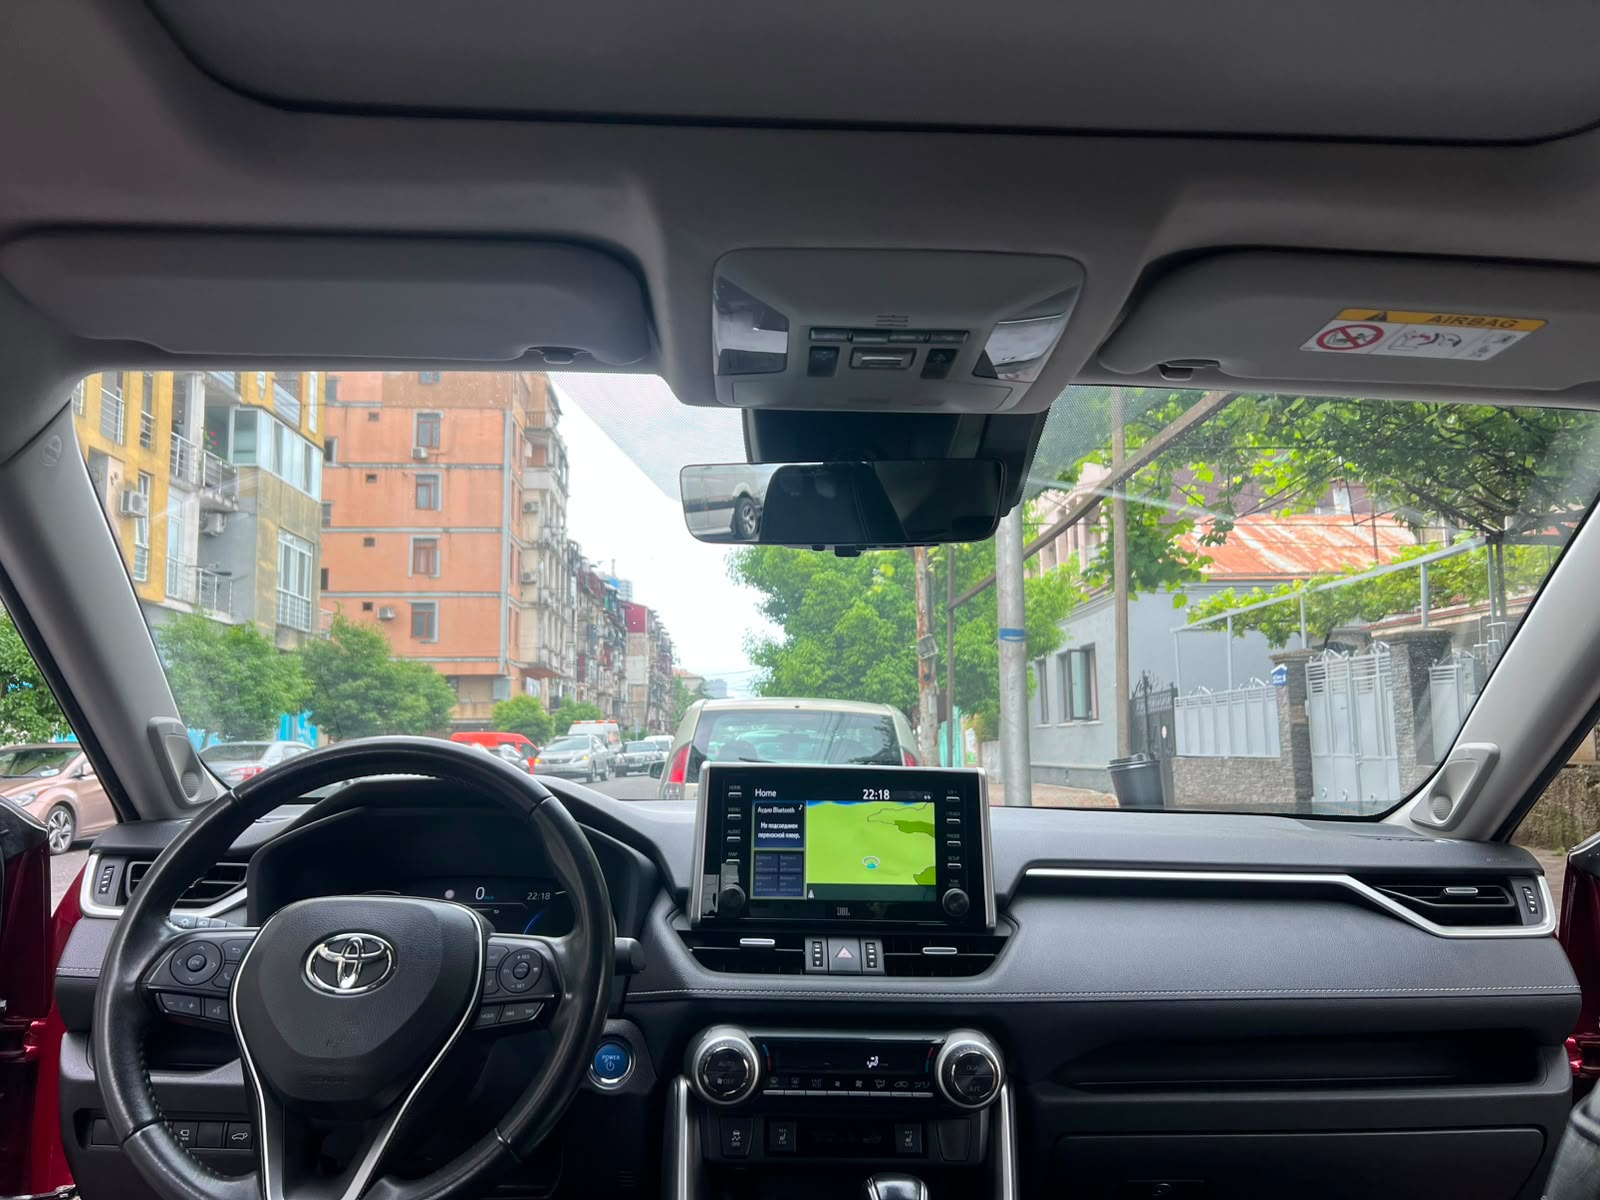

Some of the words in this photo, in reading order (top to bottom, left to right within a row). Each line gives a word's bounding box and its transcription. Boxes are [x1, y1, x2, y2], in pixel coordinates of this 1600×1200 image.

[1425, 314, 1520, 329] AIRBAG
[755, 788, 777, 798] Home
[862, 789, 890, 800] 22:18
[773, 806, 796, 814] Bluetooth
[475, 886, 486, 900] 0
[527, 891, 551, 900] 22:18
